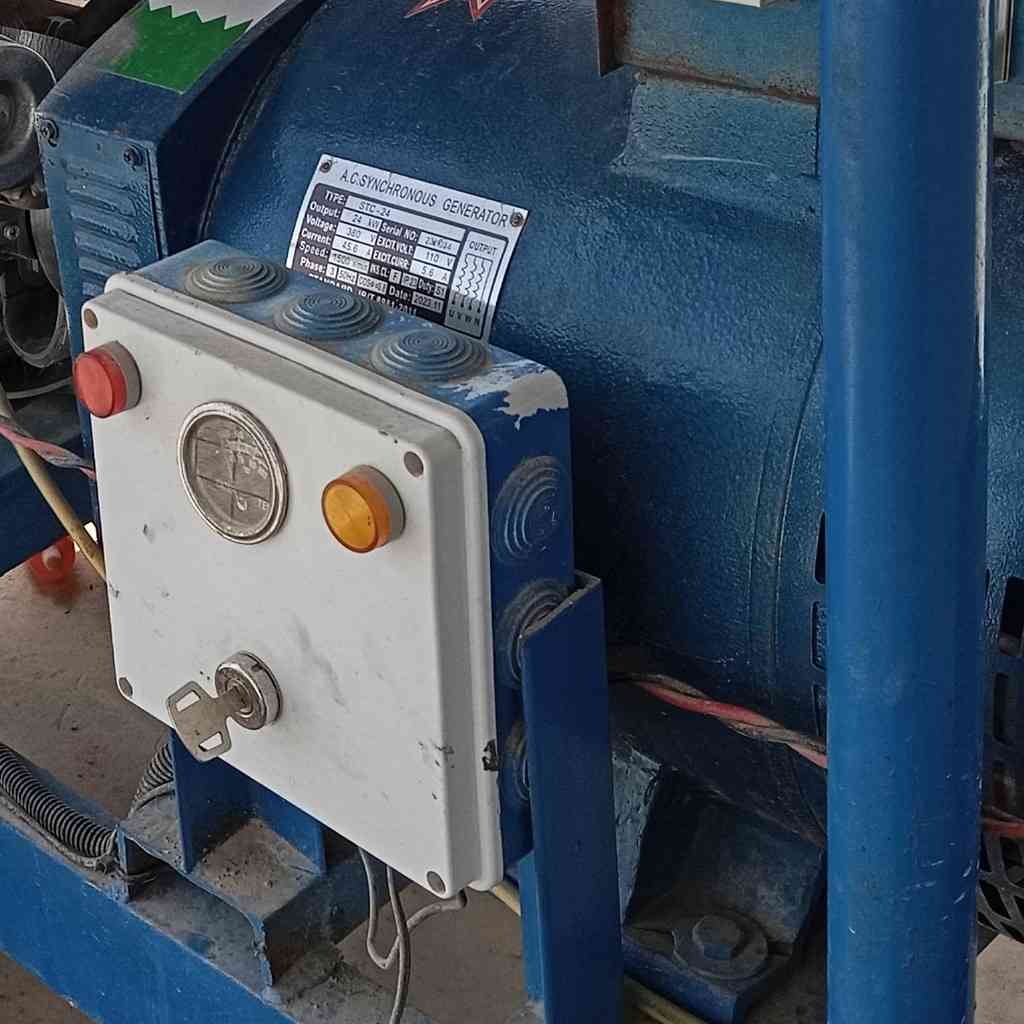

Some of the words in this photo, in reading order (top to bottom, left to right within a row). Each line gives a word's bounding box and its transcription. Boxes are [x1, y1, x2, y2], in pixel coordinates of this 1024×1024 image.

[309, 201, 341, 218] Output:
[352, 214, 362, 223] 24
[380, 222, 403, 237] Serial
[442, 198, 509, 227] GENERATOR
[299, 240, 329, 257] Speed:
[301, 228, 332, 246] Current:
[440, 272, 447, 282] A
[305, 214, 336, 233] Voltage:
[426, 251, 439, 263] 110
[468, 240, 498, 257] OUTPUT
[300, 256, 326, 275] Phase:
[388, 285, 412, 302] Date:
